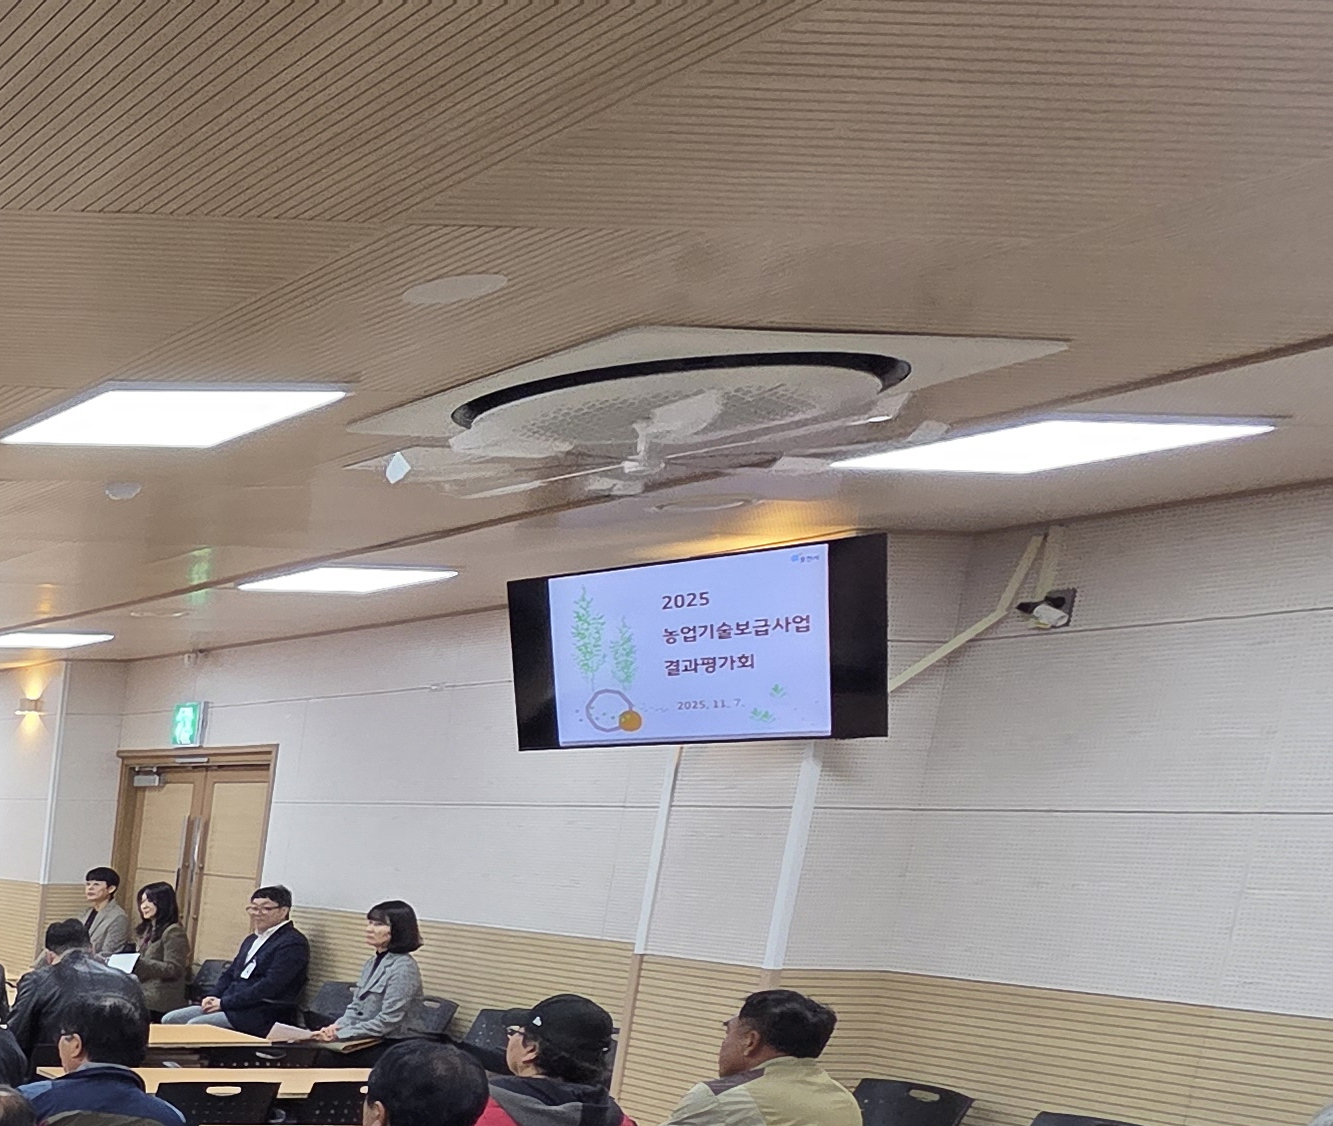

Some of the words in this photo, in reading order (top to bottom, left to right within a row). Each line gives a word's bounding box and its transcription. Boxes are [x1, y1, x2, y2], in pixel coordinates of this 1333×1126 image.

[661, 591, 710, 610] 2025
[662, 614, 811, 645] 농업기술보급사업
[664, 653, 755, 677] 결과평가회
